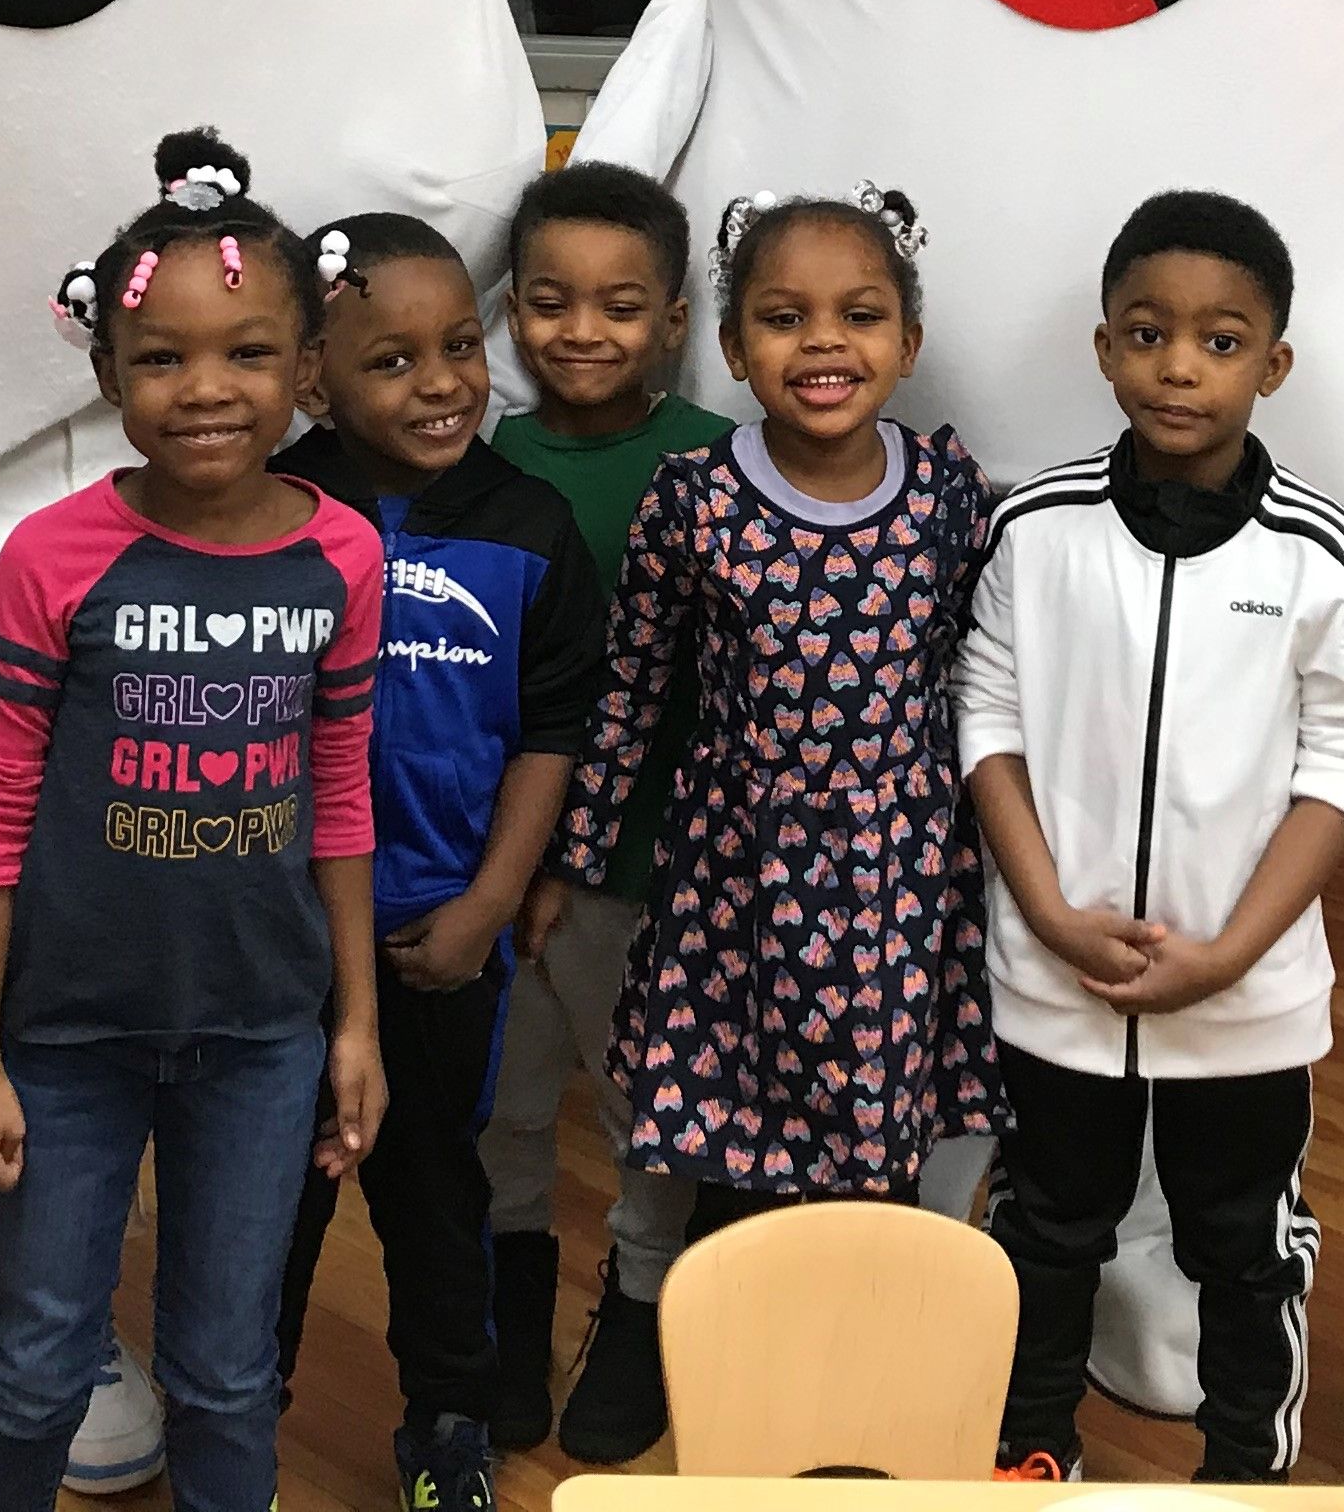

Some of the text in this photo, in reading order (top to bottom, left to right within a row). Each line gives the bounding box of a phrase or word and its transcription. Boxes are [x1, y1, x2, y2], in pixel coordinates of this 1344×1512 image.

[114, 603, 335, 653] GRL PWR
[1230, 600, 1283, 617] adidas
[113, 672, 207, 726] GRL
[110, 736, 201, 793] GRL
[106, 800, 197, 859] GRL
